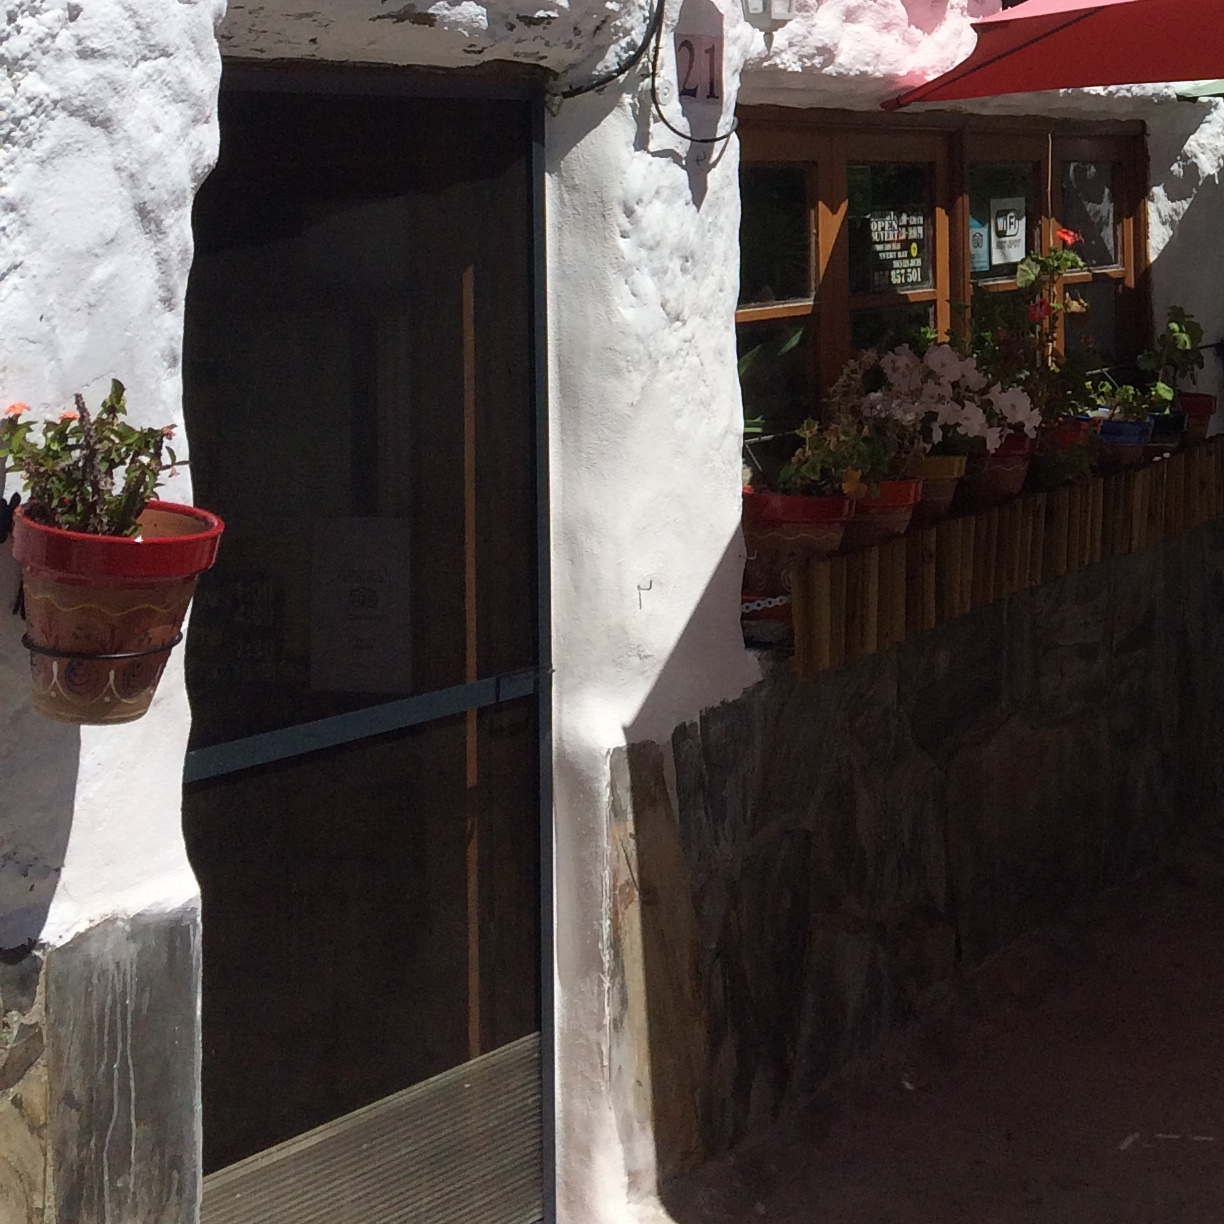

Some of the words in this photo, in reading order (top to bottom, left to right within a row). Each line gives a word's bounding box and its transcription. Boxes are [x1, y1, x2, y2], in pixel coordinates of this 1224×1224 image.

[678, 39, 719, 100] 21
[871, 220, 898, 232] OPEN
[906, 267, 921, 283] 501
